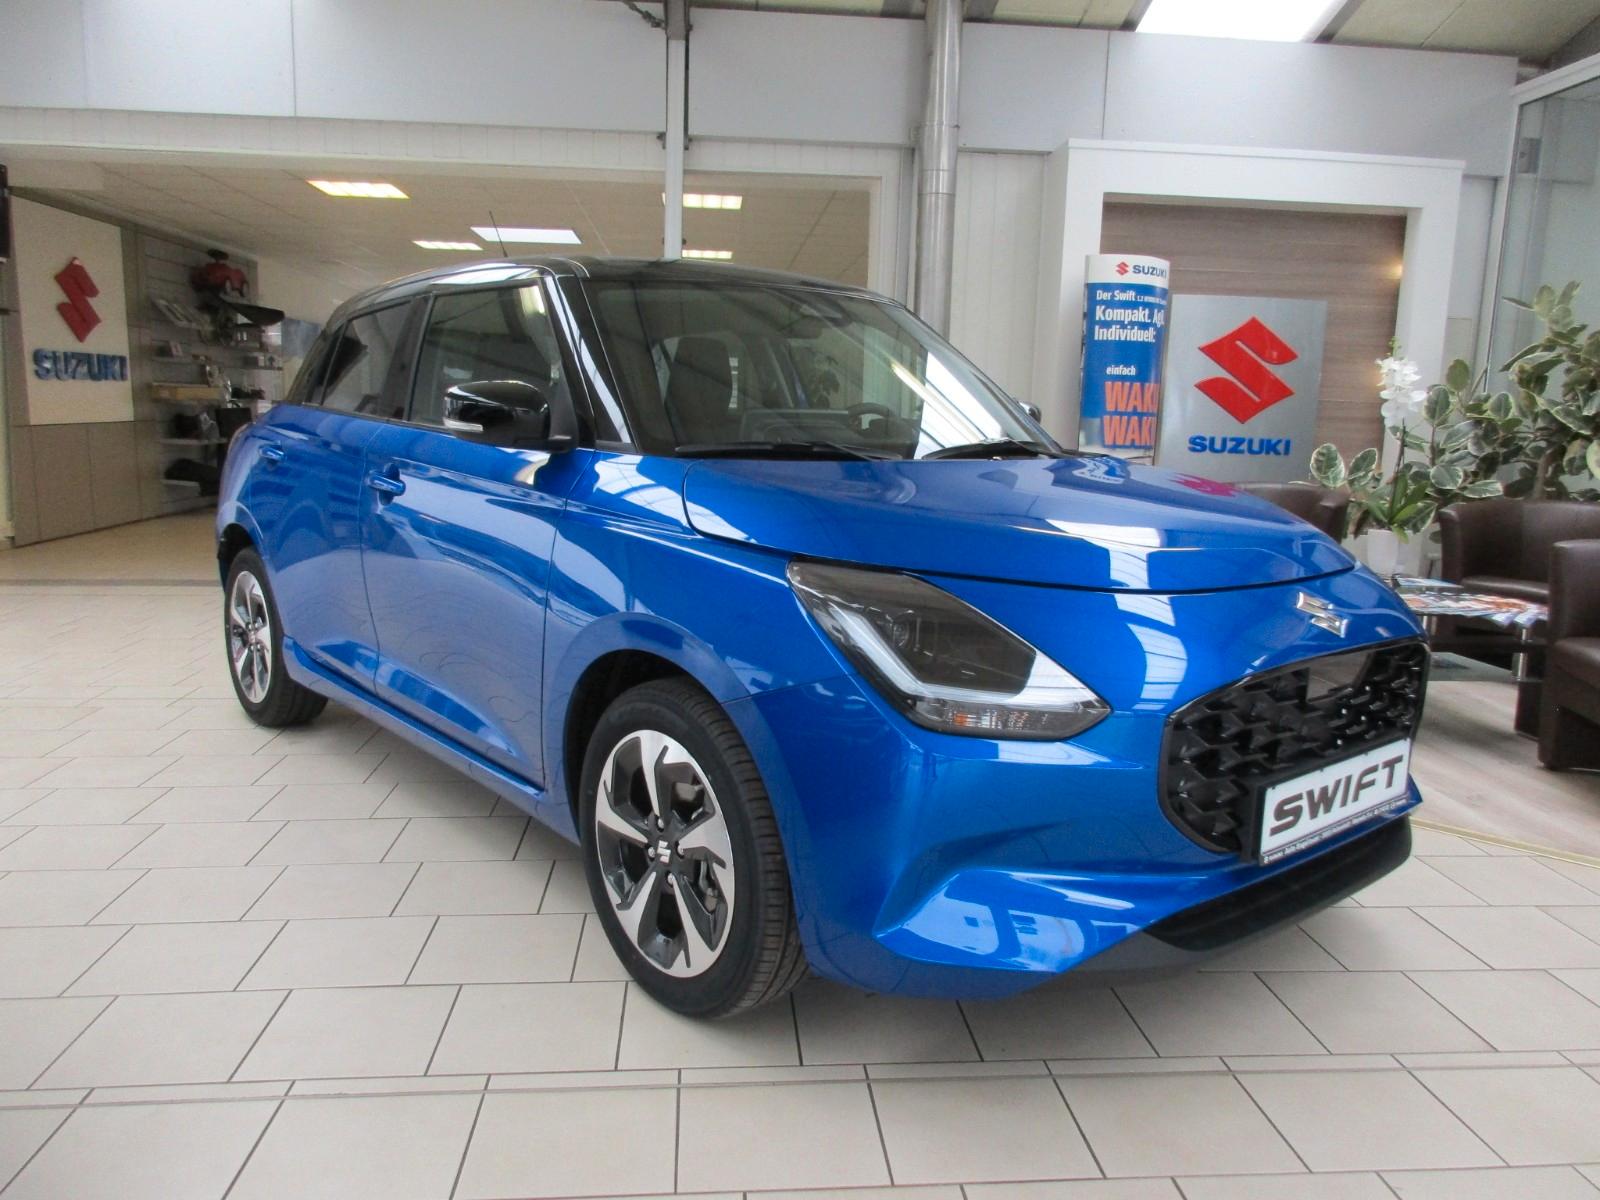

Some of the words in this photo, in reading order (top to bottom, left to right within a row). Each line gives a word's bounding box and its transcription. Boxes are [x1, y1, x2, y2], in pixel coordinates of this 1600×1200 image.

[1132, 264, 1167, 279] SUZUKI
[1096, 289, 1113, 301] Der
[1113, 289, 1136, 301] Swift
[1095, 305, 1151, 325] Kompakt.
[33, 348, 128, 381] SUZUKI
[1106, 365, 1136, 376] einfach
[1188, 435, 1291, 457] SUZUKI
[1269, 754, 1404, 838] SWIFT
